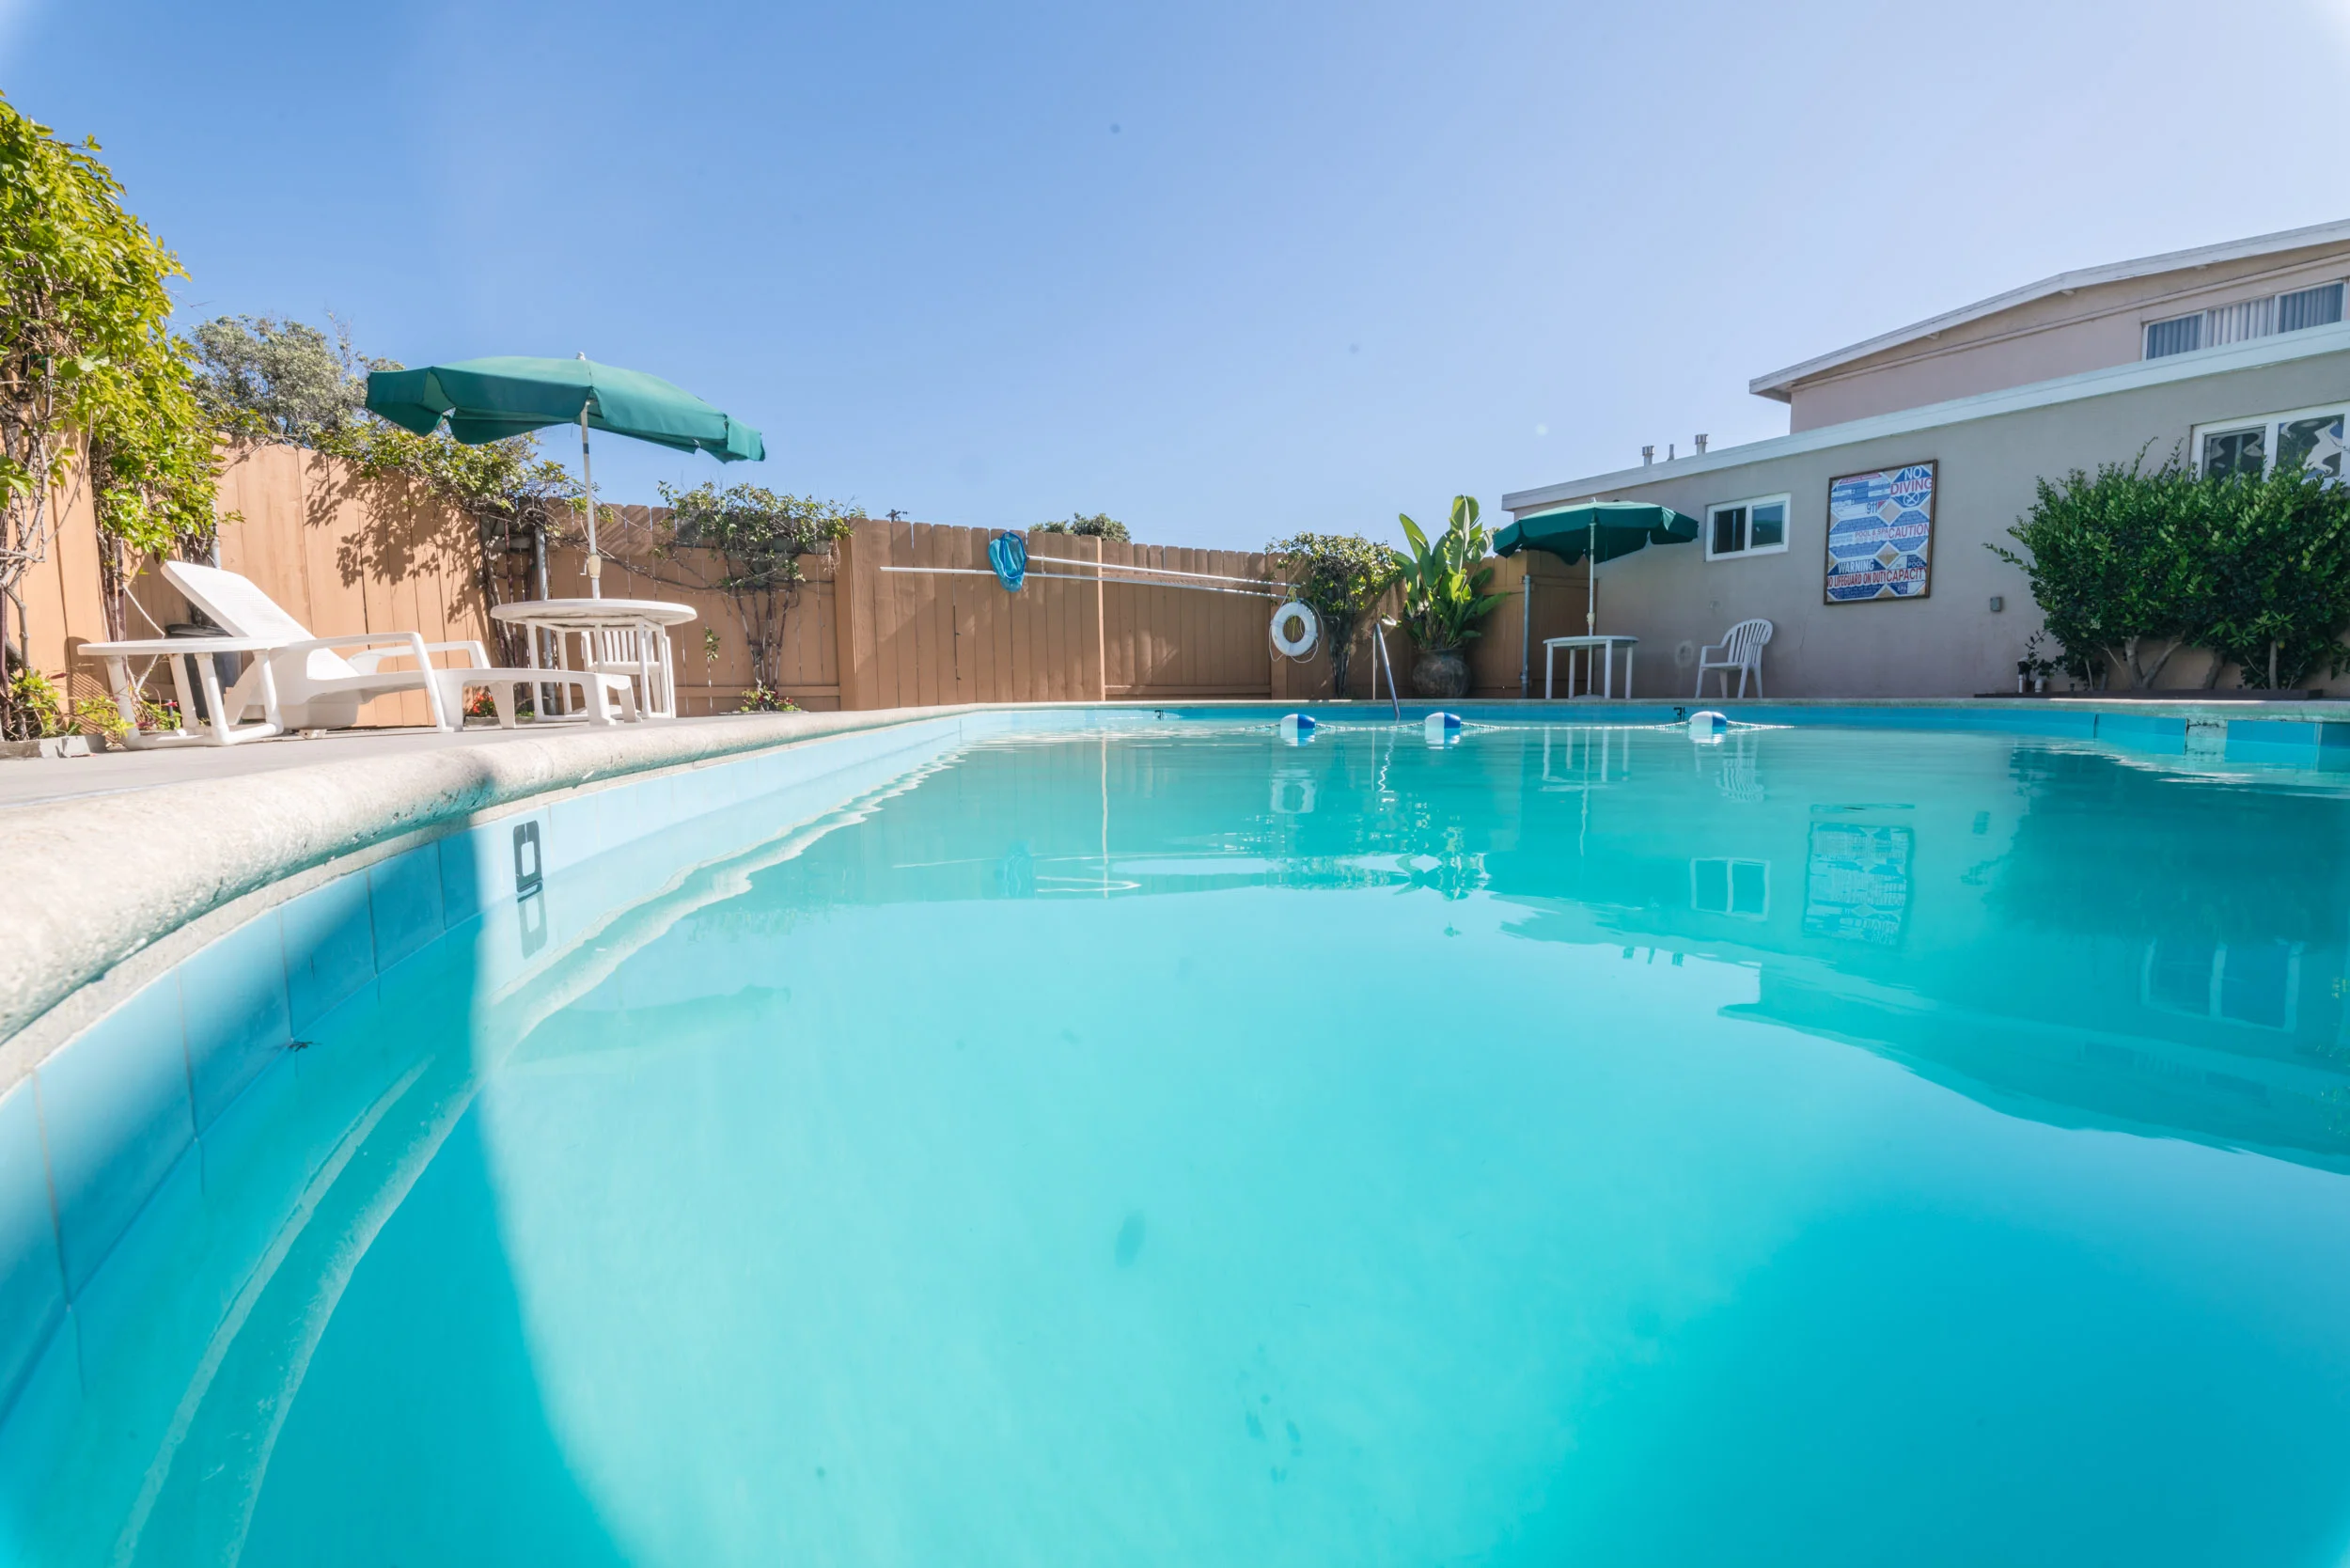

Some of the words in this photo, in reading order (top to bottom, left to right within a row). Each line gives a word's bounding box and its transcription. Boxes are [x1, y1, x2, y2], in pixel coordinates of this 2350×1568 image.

[1904, 466, 1921, 480] NO
[1890, 477, 1933, 495] DIVING
[1866, 500, 1878, 514] 911
[1838, 559, 1874, 574] WARNING
[1834, 572, 1862, 587] LIFEGUARD
[1863, 572, 1872, 585] ON
[1872, 570, 1887, 583] DUTY
